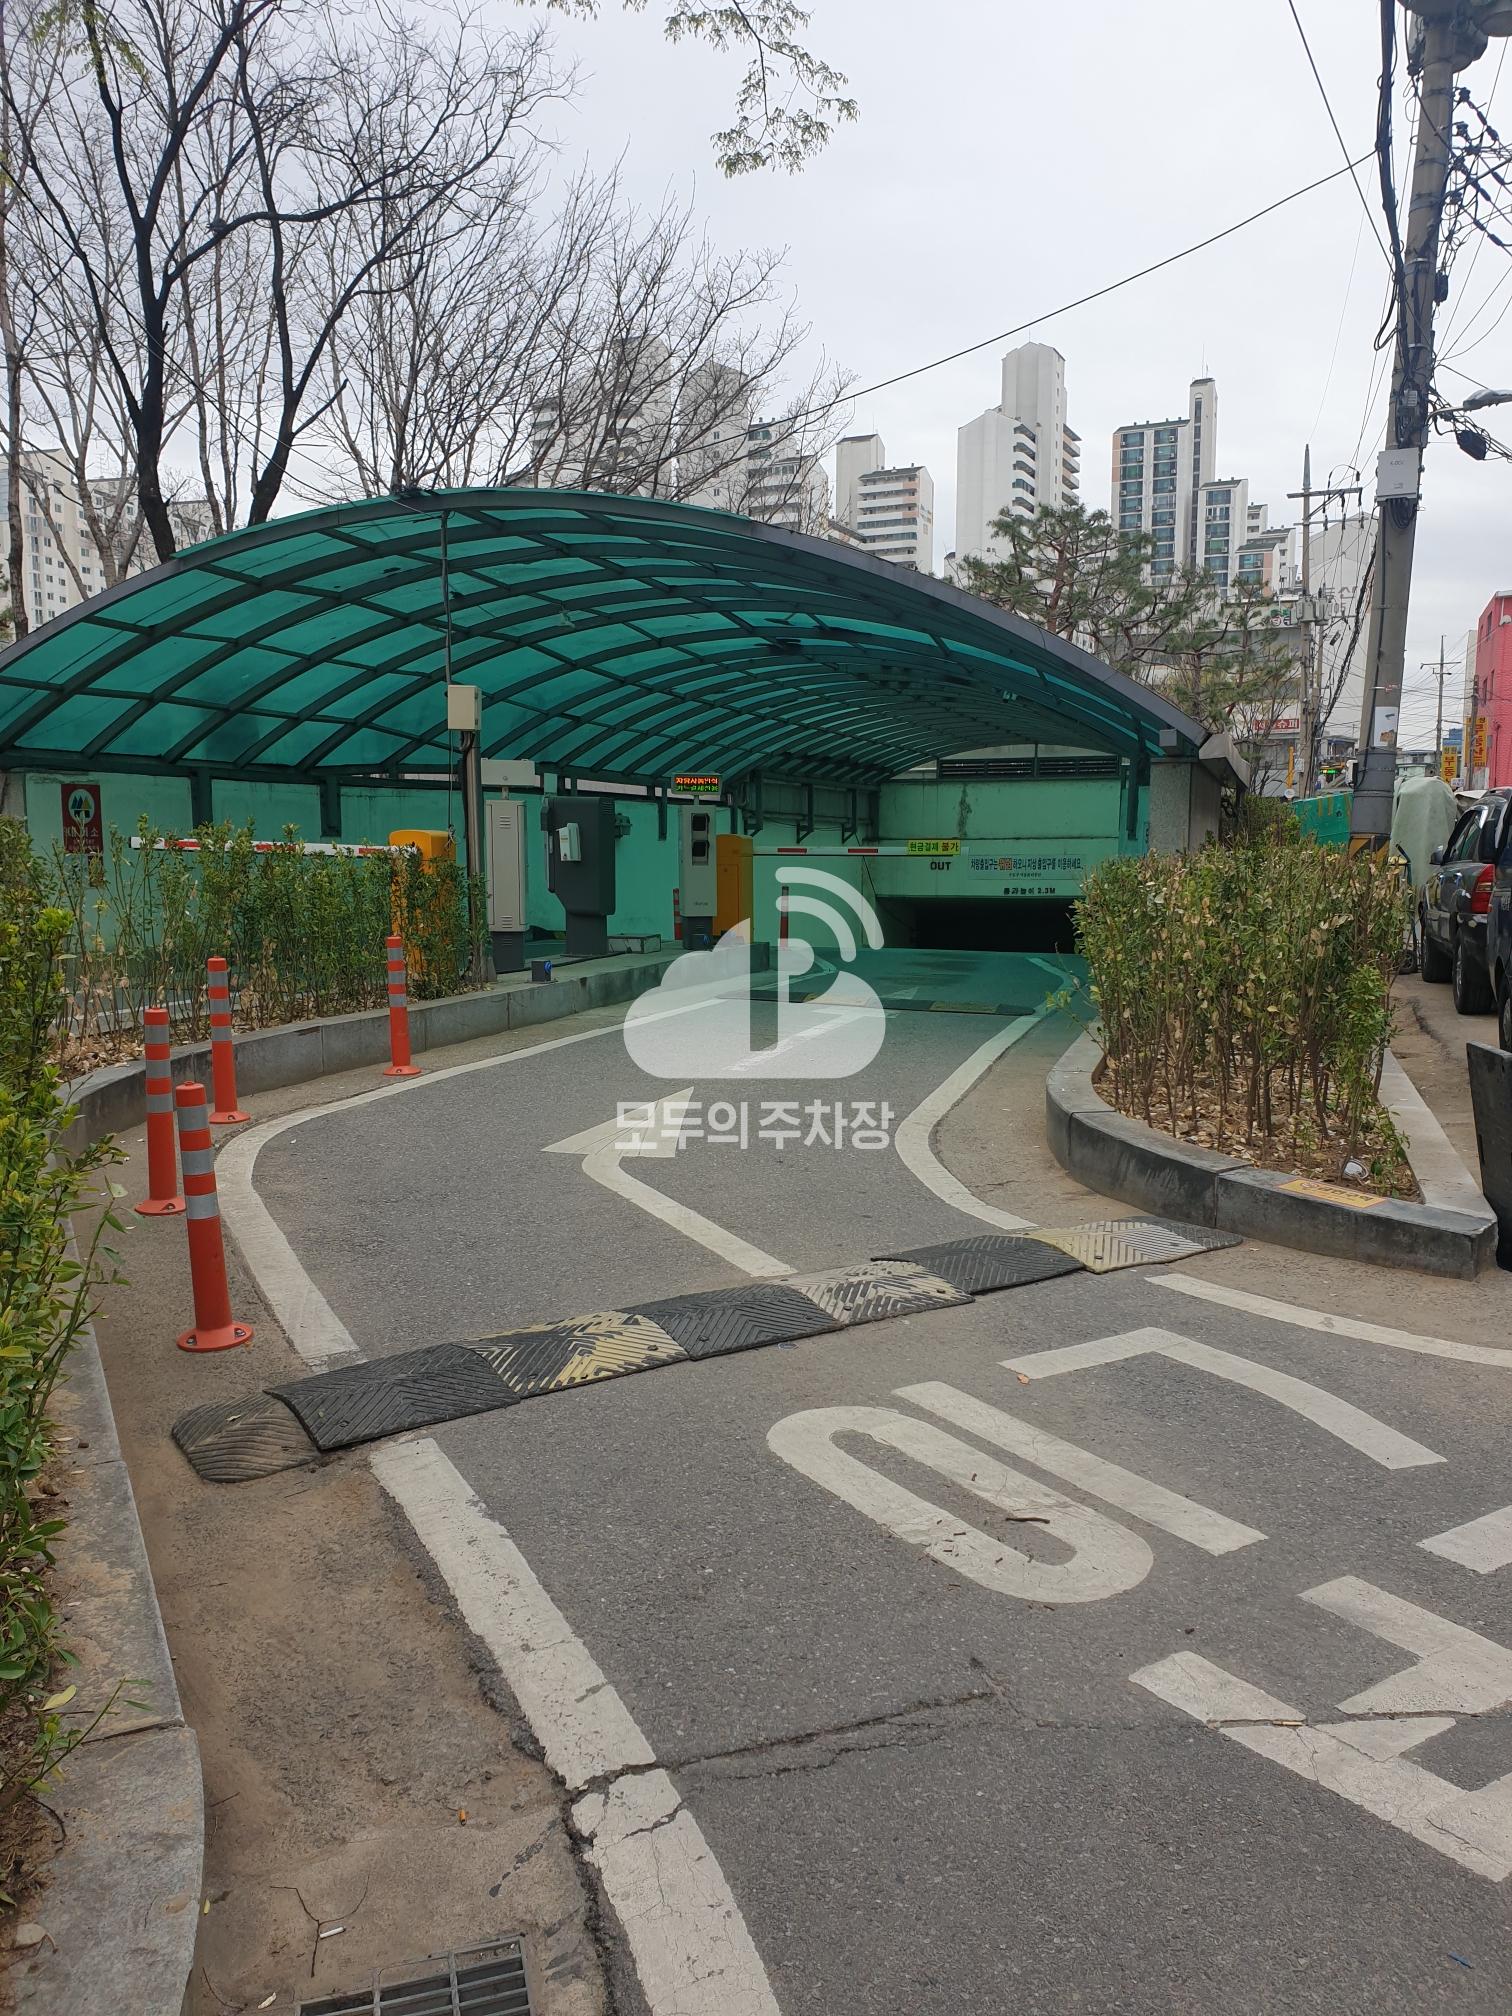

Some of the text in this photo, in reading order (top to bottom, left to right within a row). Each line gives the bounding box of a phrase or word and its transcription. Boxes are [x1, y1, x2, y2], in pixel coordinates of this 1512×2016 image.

[909, 841, 959, 852] 현금결제 불가
[930, 861, 952, 871] OUT
